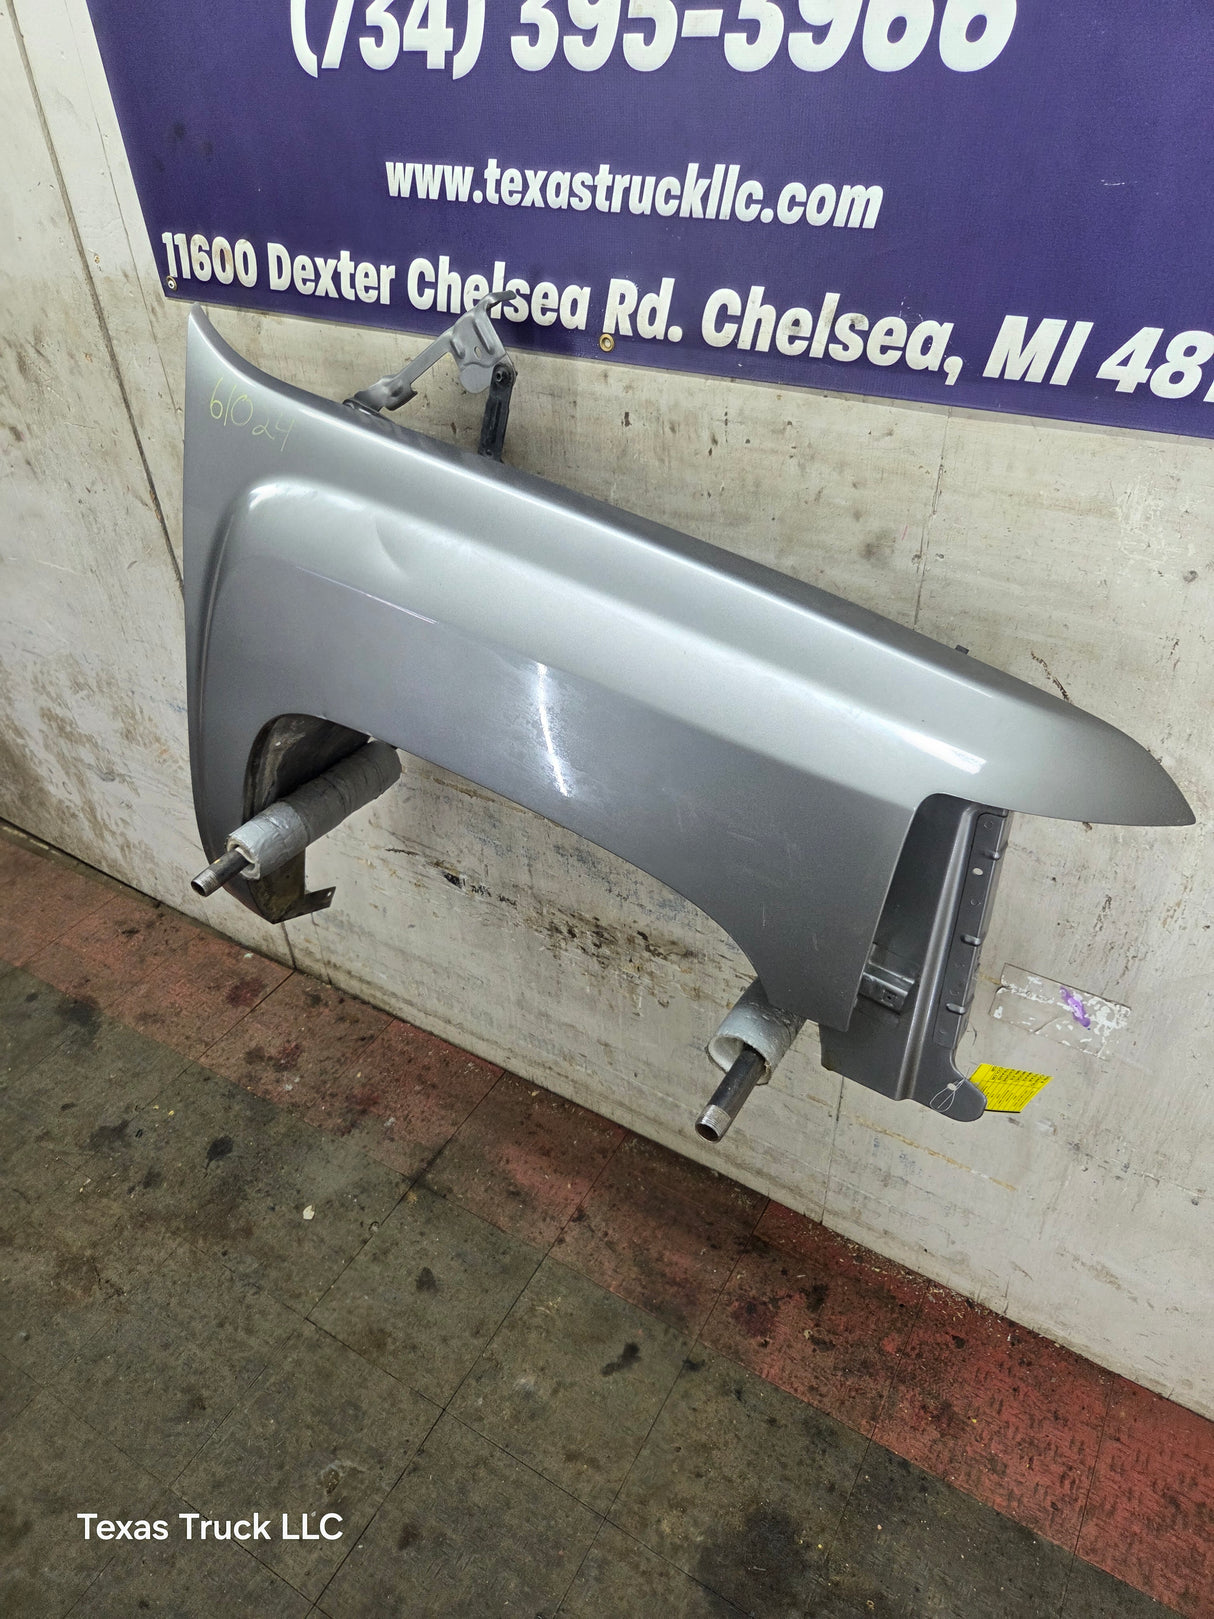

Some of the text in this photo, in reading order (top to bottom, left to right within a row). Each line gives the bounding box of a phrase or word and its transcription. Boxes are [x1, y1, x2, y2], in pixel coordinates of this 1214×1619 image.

[289, 0, 1018, 80] (734) 395-3966
[384, 157, 884, 230] www.texastruckllc.com
[161, 232, 1214, 403] 11600 Dexter Chelsea Rd. Chelsea, MI 48
